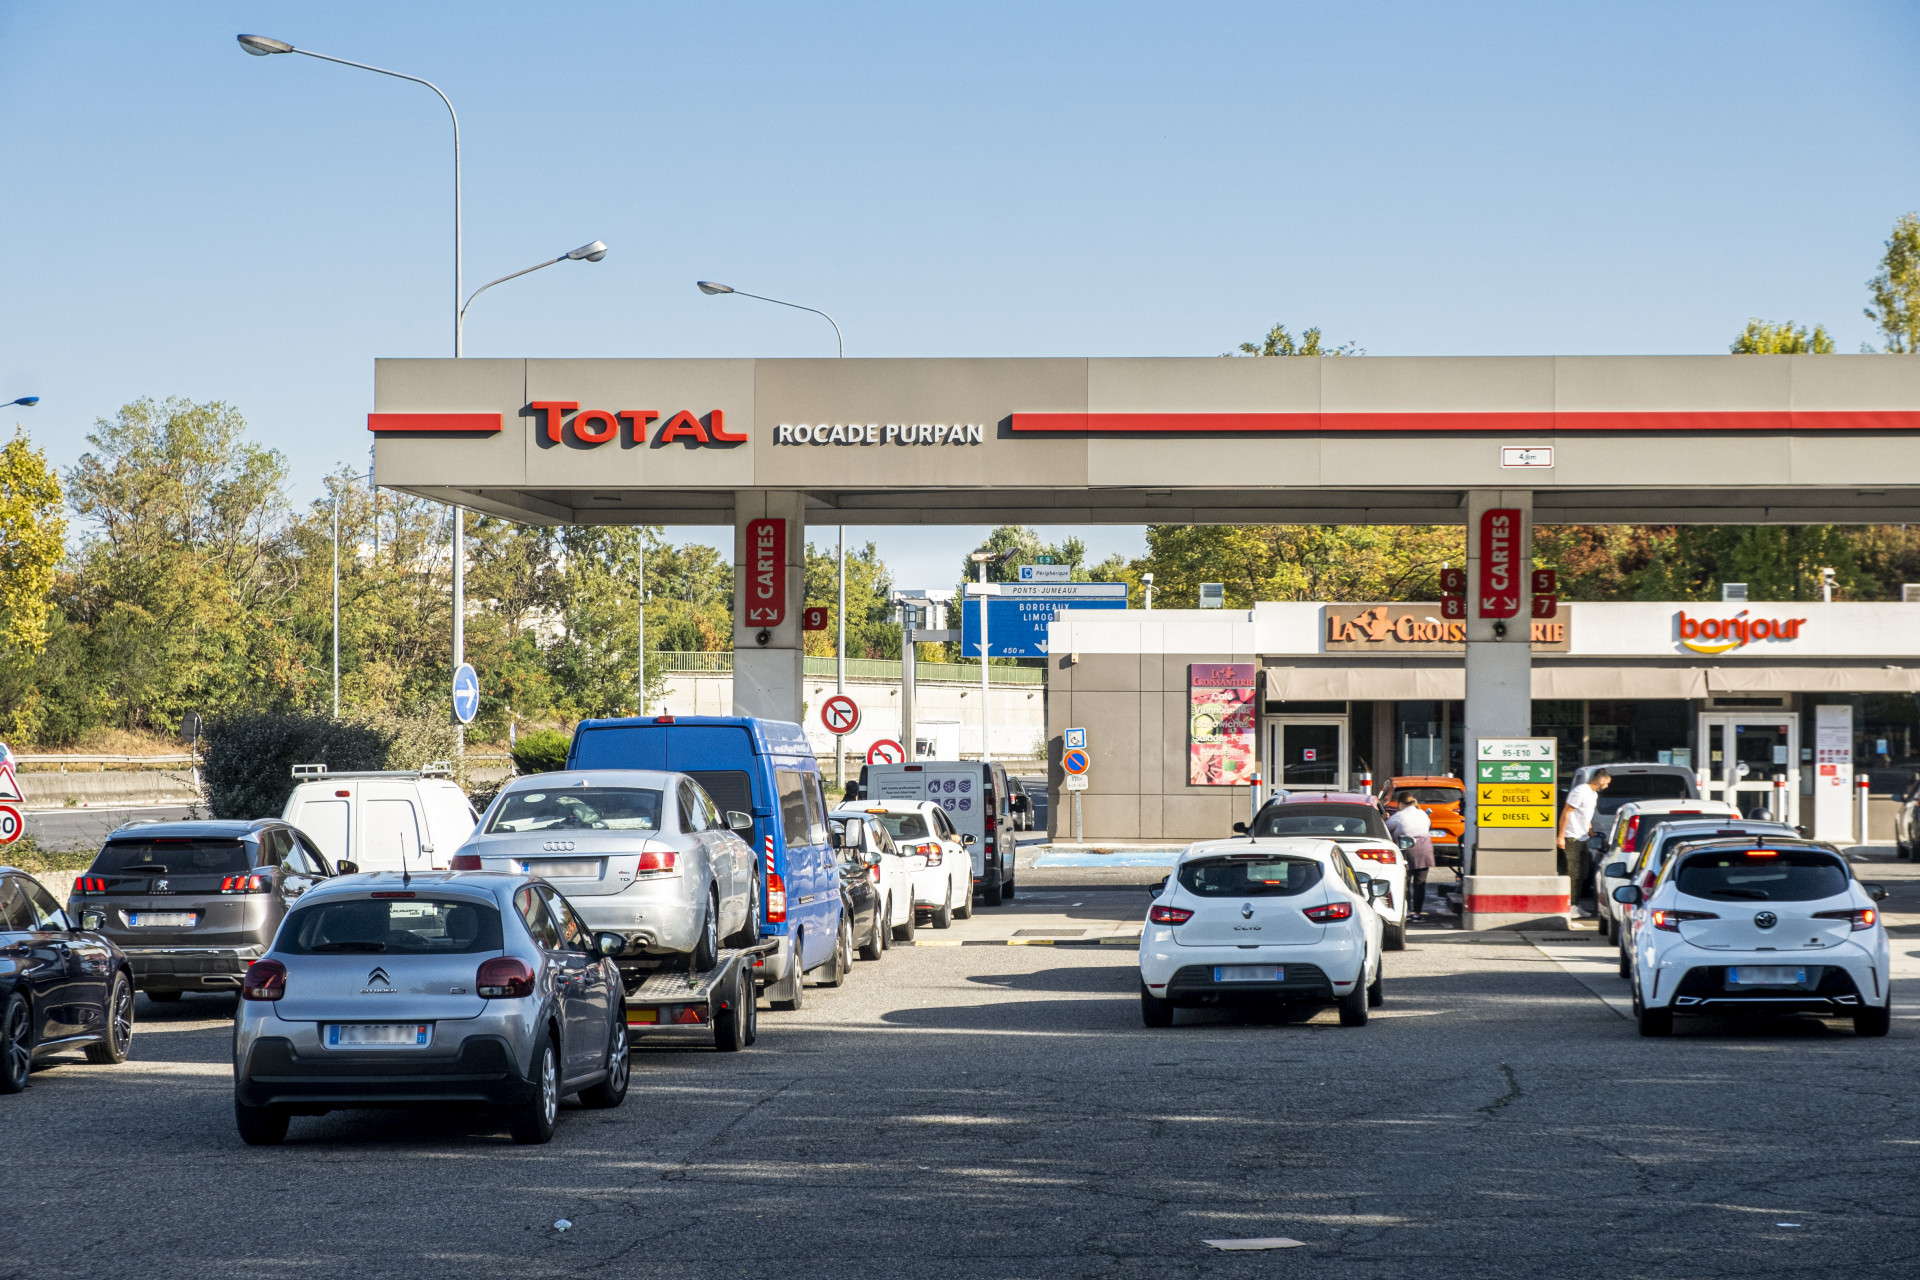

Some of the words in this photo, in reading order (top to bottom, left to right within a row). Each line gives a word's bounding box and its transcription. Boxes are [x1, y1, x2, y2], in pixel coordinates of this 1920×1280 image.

[532, 401, 748, 443] TOTAL
[779, 423, 878, 443] ROCADE
[885, 423, 983, 443] PURPAN
[1491, 515, 1510, 591] CARTES
[757, 524, 774, 599] CARTES
[1446, 573, 1457, 588] 6
[1539, 574, 1549, 588] 5
[1019, 603, 1070, 611] BORDEAUX
[1447, 600, 1458, 615] 8
[1540, 599, 1550, 613] 7
[811, 612, 821, 626] 9
[1331, 615, 1357, 641] LA
[1680, 609, 1807, 646] bonjour
[1192, 677, 1254, 686] CROISSANTERIE
[1211, 692, 1233, 700] Café
[1196, 719, 1248, 728] Sandwiches
[1502, 795, 1530, 803] DIESEL
